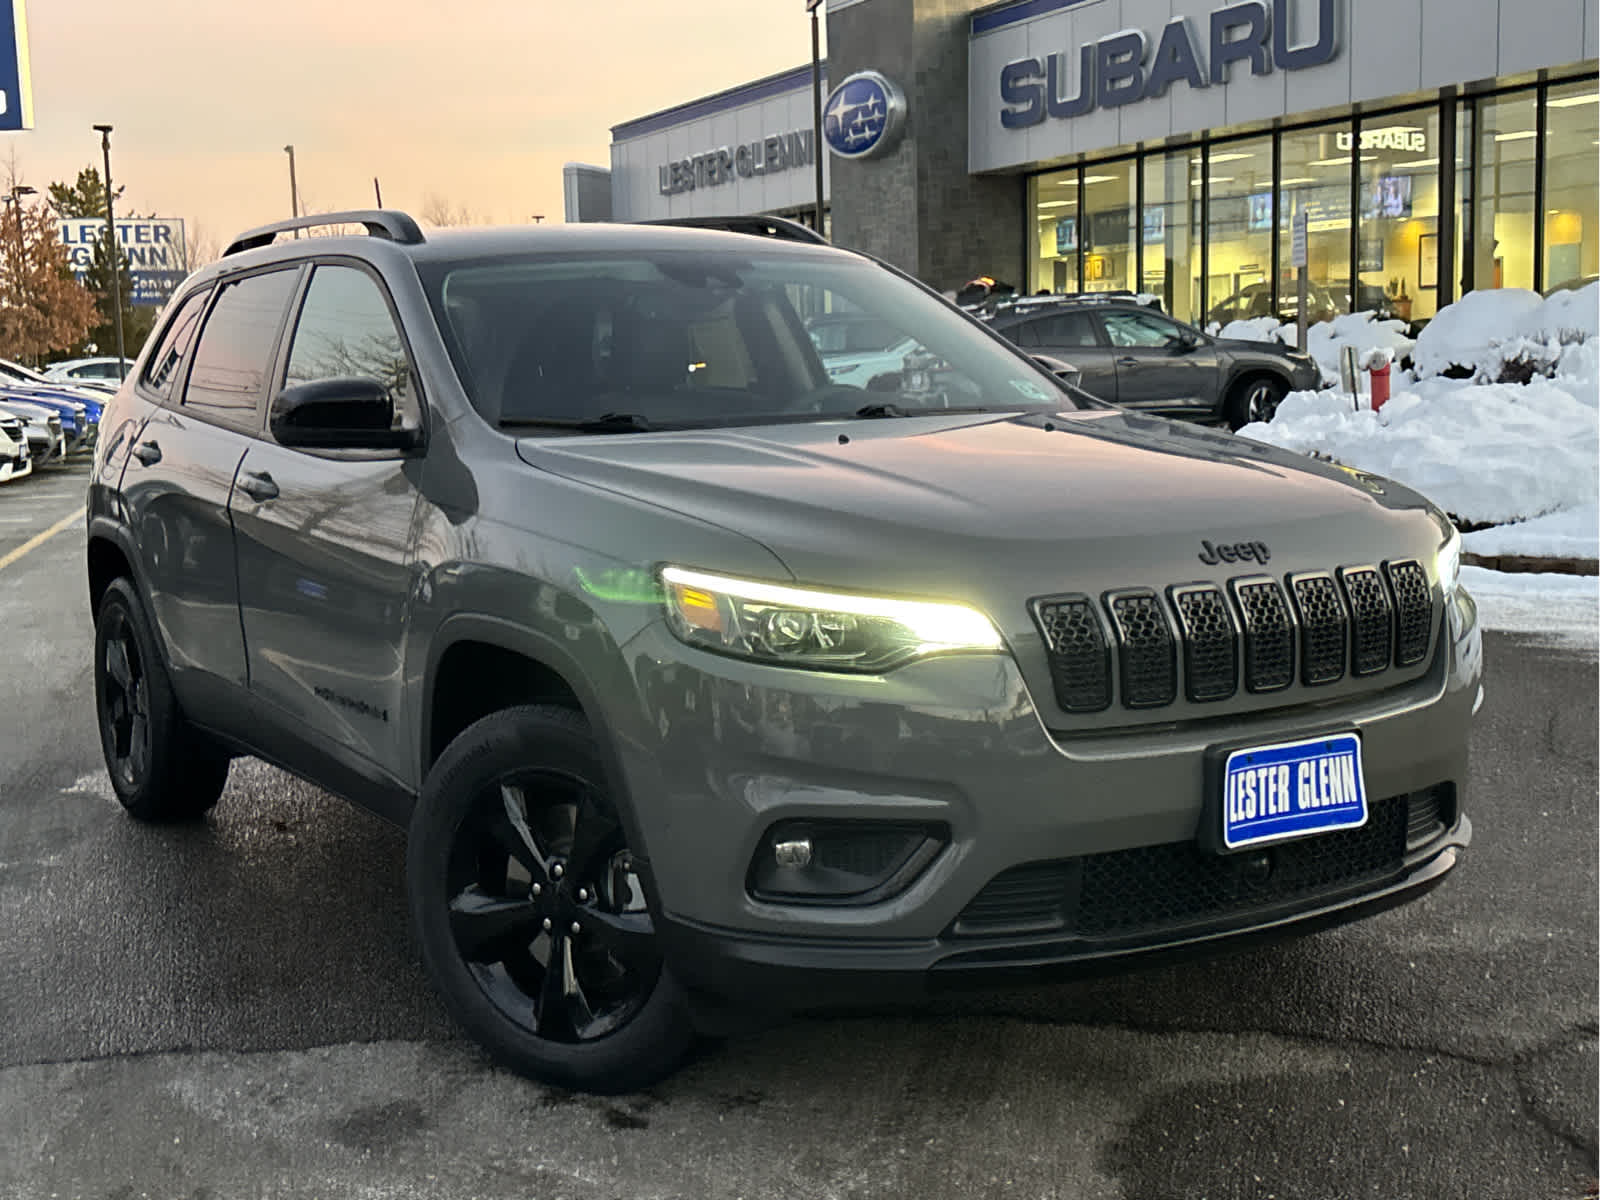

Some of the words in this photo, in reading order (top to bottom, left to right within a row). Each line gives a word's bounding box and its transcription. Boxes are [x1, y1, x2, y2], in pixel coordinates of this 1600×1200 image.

[1000, 0, 1338, 128] SUBARU
[659, 147, 735, 195] LESTER
[736, 128, 815, 178] GLENN
[71, 247, 168, 266] GNN
[1198, 540, 1271, 566] Jeep
[1229, 764, 1290, 823] LESTER
[1298, 754, 1357, 810] GLENN
